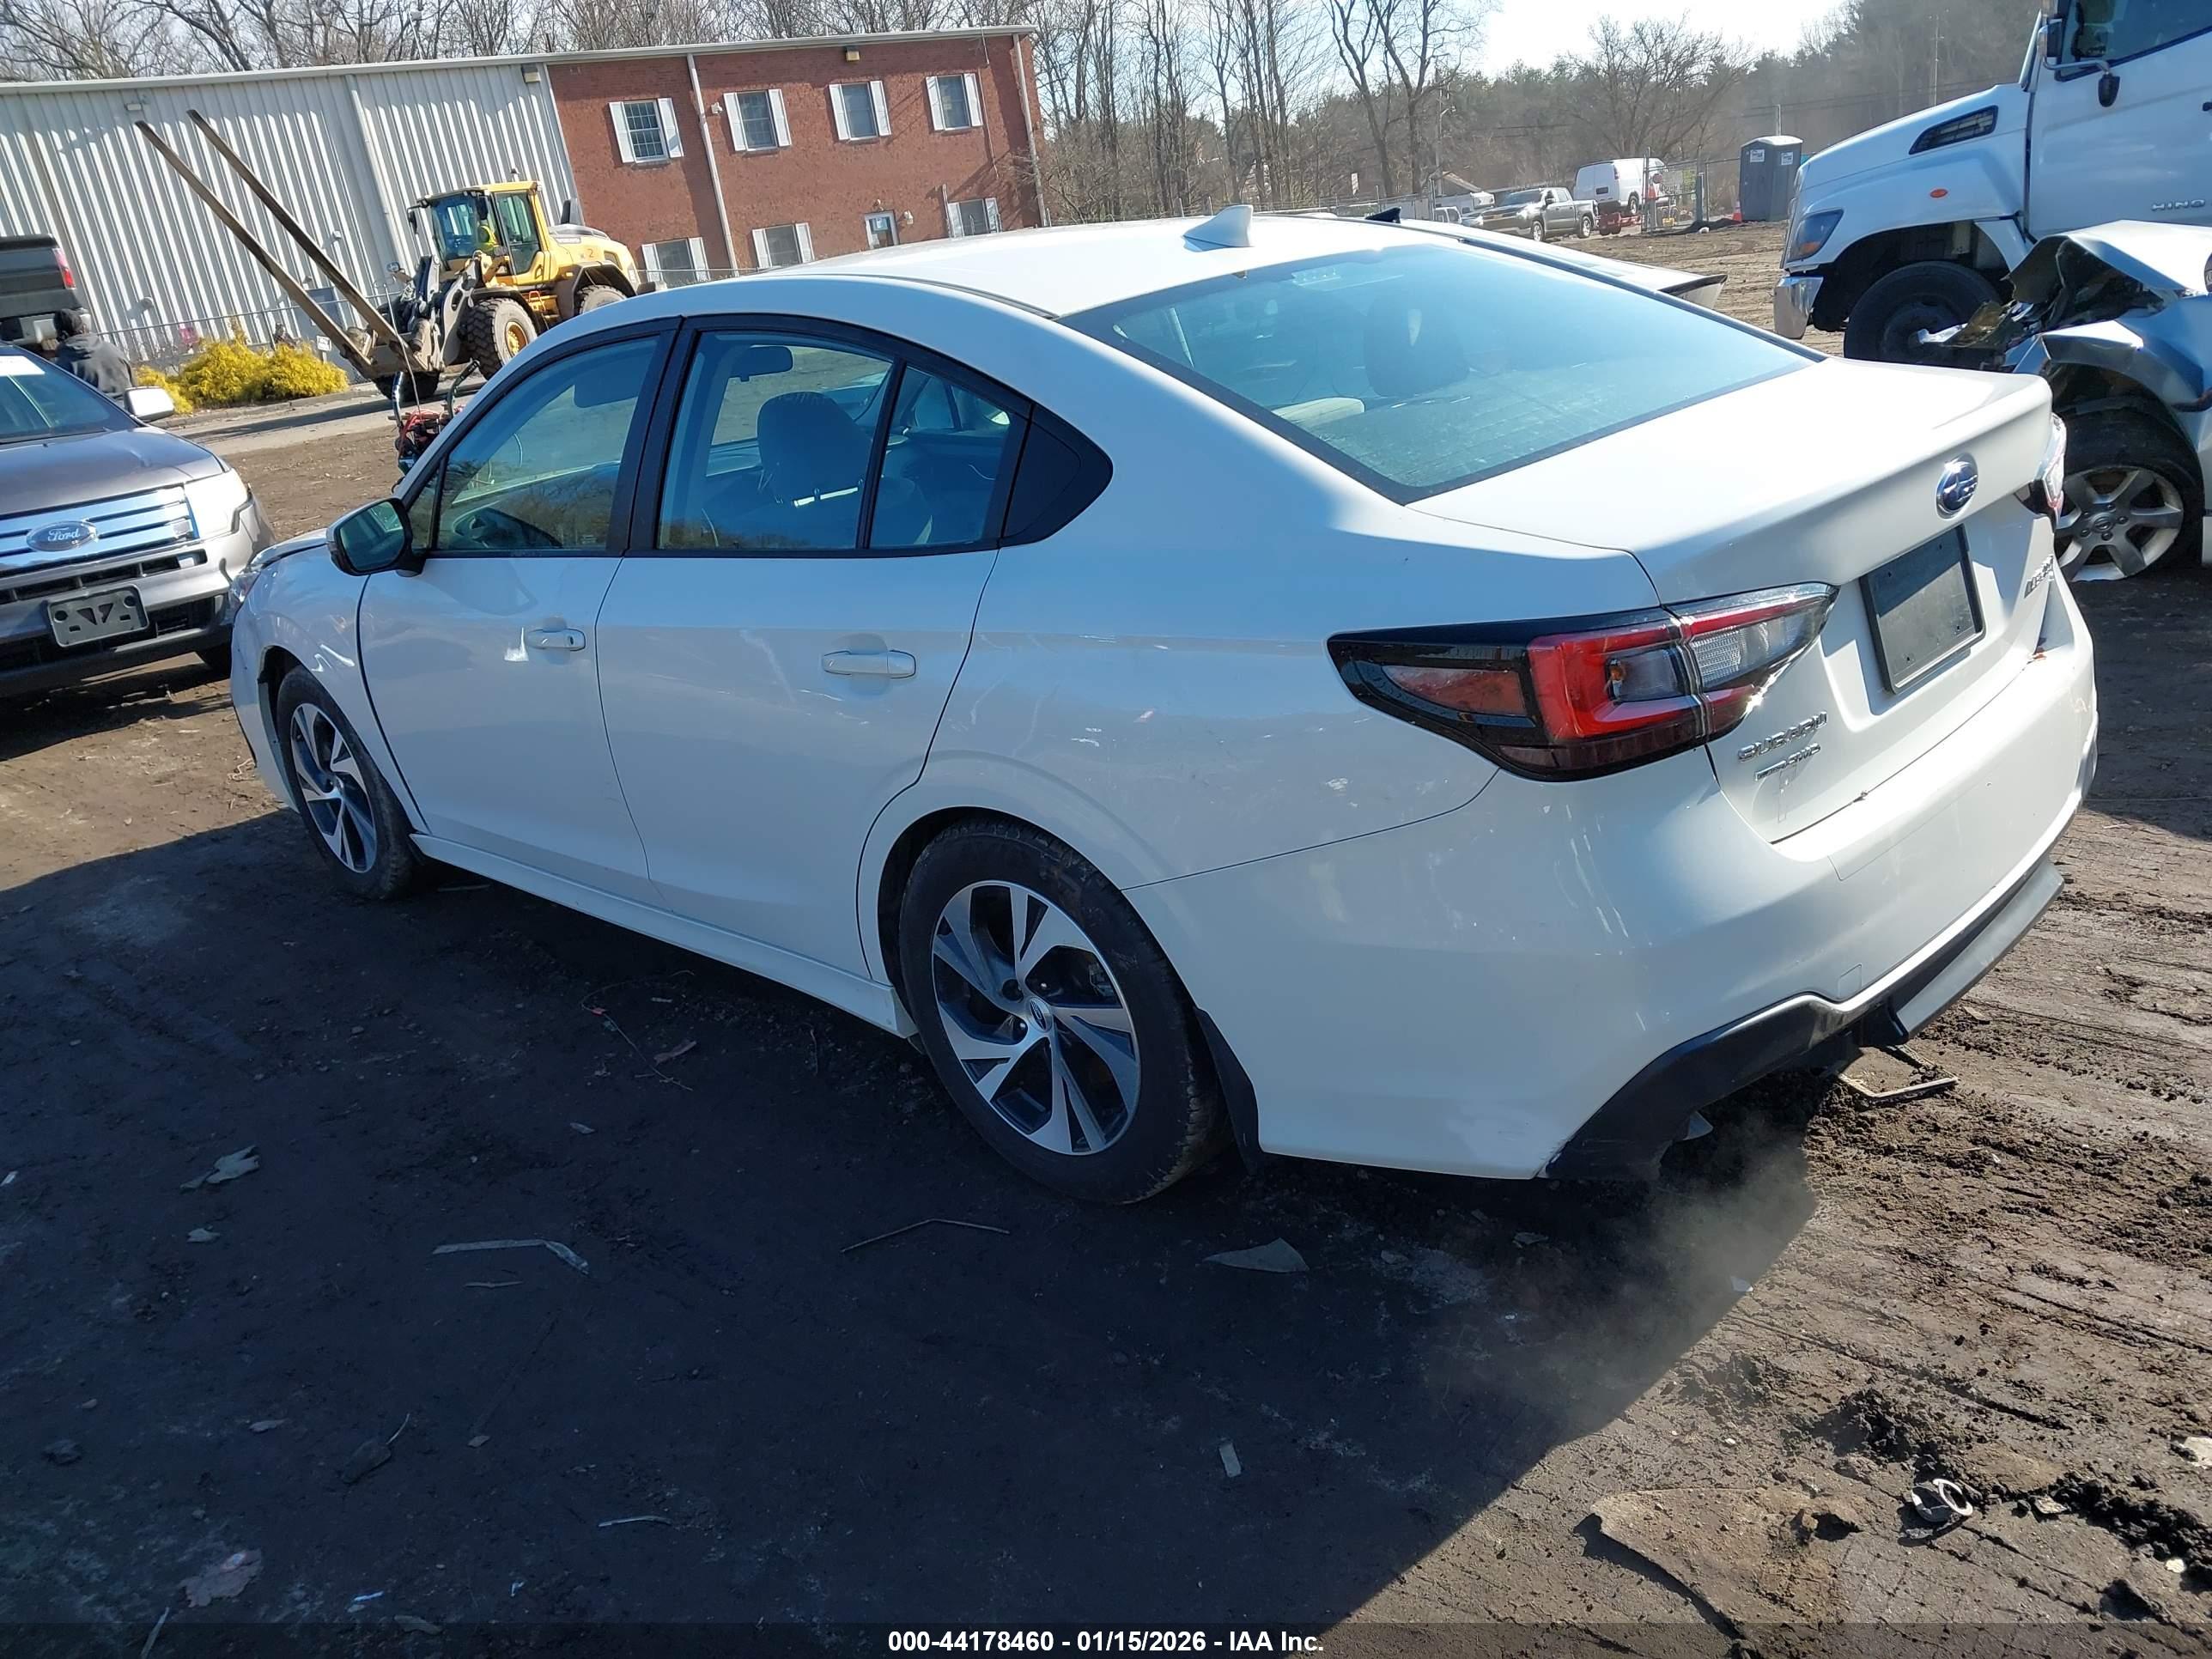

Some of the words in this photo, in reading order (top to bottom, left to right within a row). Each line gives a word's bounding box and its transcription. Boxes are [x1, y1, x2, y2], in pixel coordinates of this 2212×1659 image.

[2151, 198, 2205, 212] HINO
[47, 526, 81, 542] Ford
[1738, 711, 1827, 763] SUBARU
